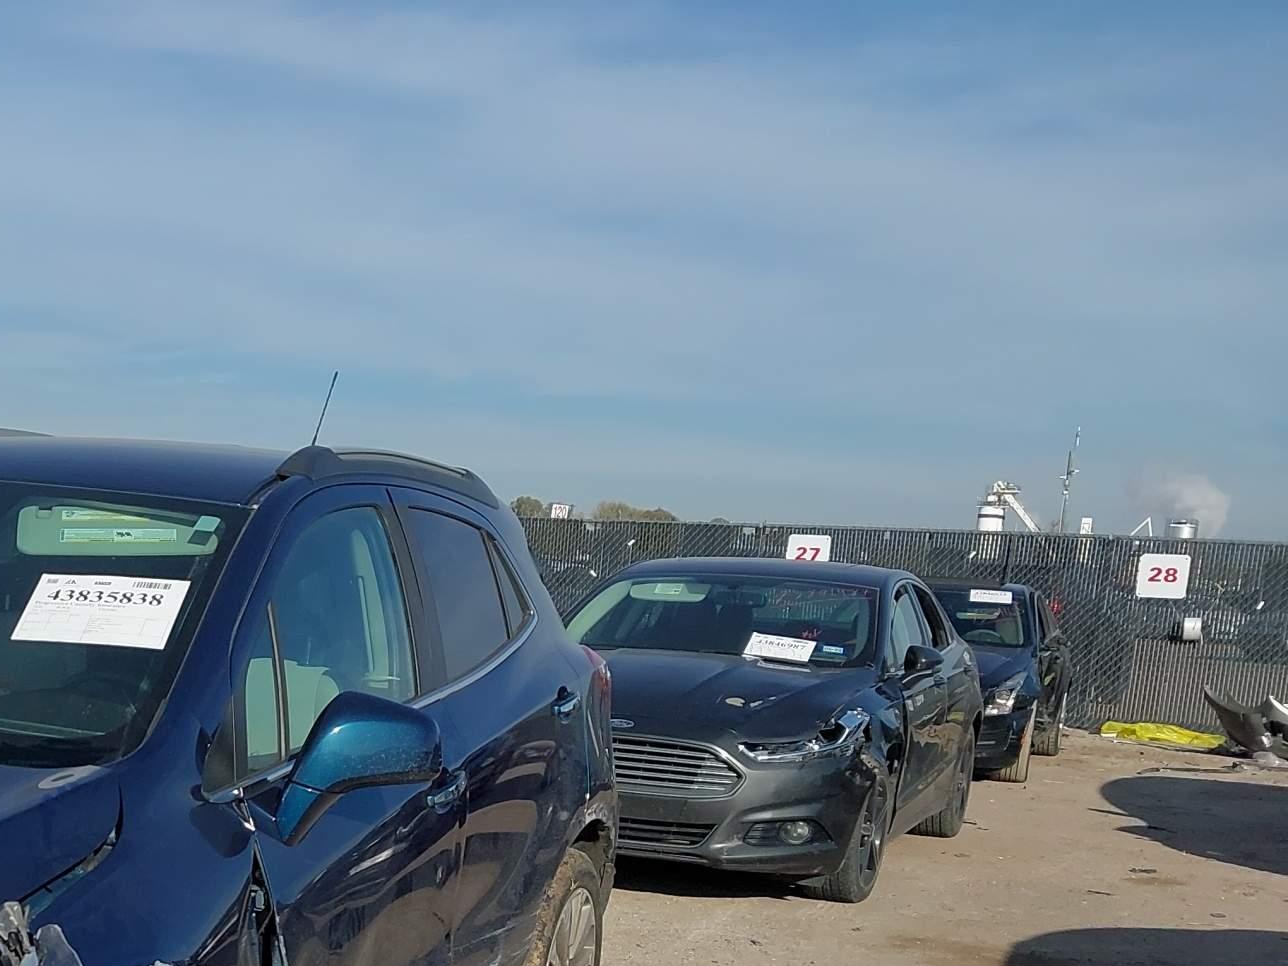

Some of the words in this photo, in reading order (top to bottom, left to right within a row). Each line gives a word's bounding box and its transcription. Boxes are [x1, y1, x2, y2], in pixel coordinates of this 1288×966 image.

[795, 547, 821, 561] 27
[1147, 567, 1178, 583] 28
[47, 588, 165, 607] 43835838
